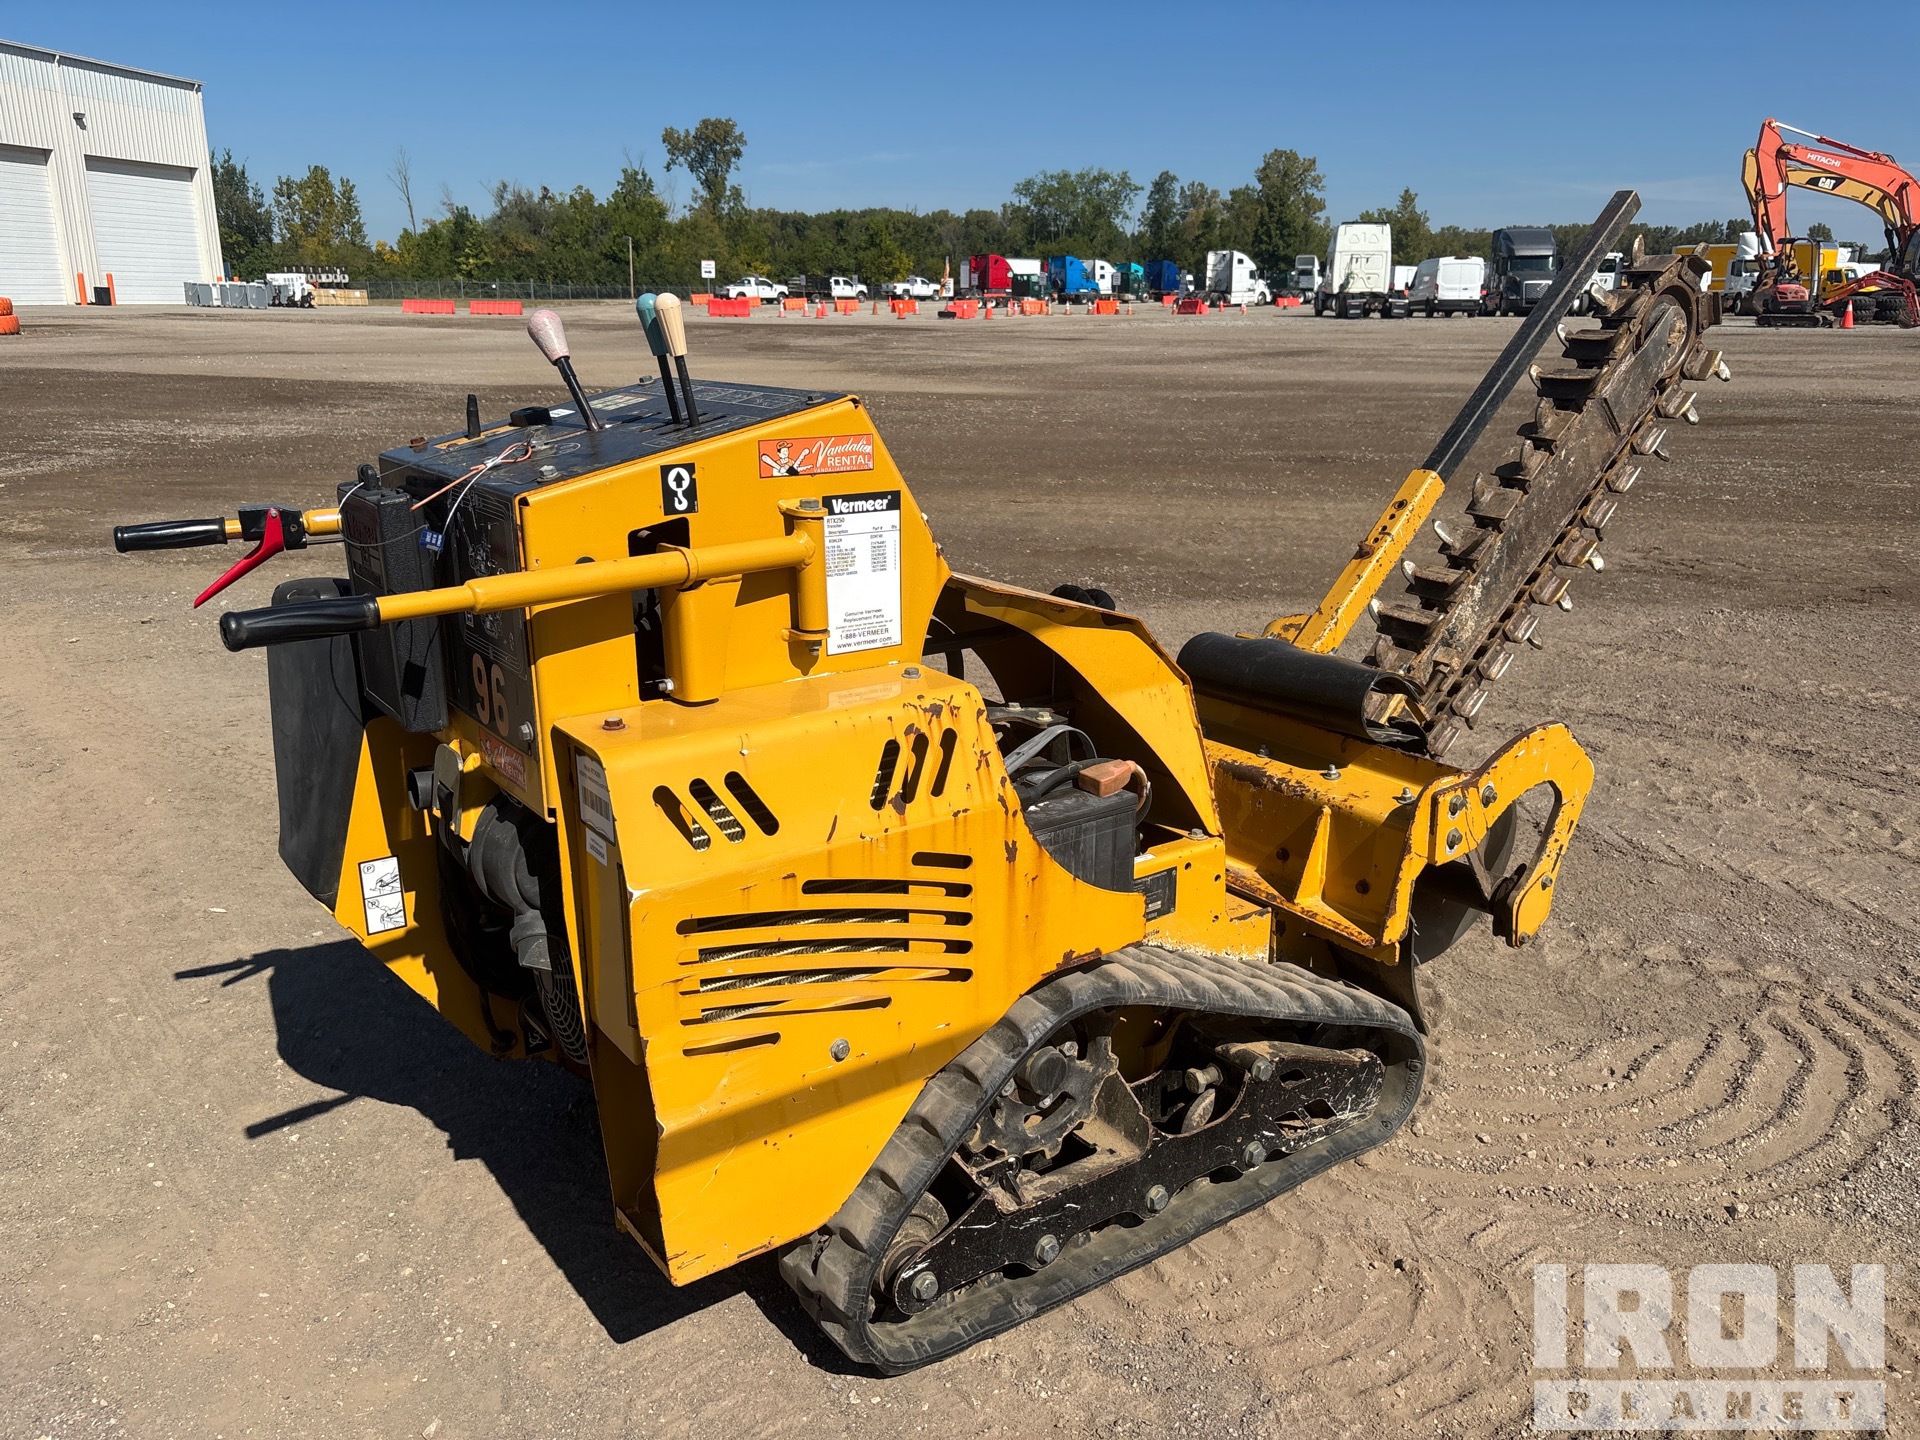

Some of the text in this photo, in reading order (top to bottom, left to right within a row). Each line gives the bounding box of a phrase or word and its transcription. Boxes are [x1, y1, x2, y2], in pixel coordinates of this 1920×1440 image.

[1807, 152, 1841, 167] HITACHI
[1818, 177, 1836, 190] CAT
[812, 437, 872, 467] Vandalia
[827, 455, 871, 466] RENTAL
[831, 498, 888, 514] Vermeer
[840, 628, 889, 640] 1-888-VERMEER
[837, 636, 892, 649] www.vermeer.com
[472, 652, 509, 737] 96
